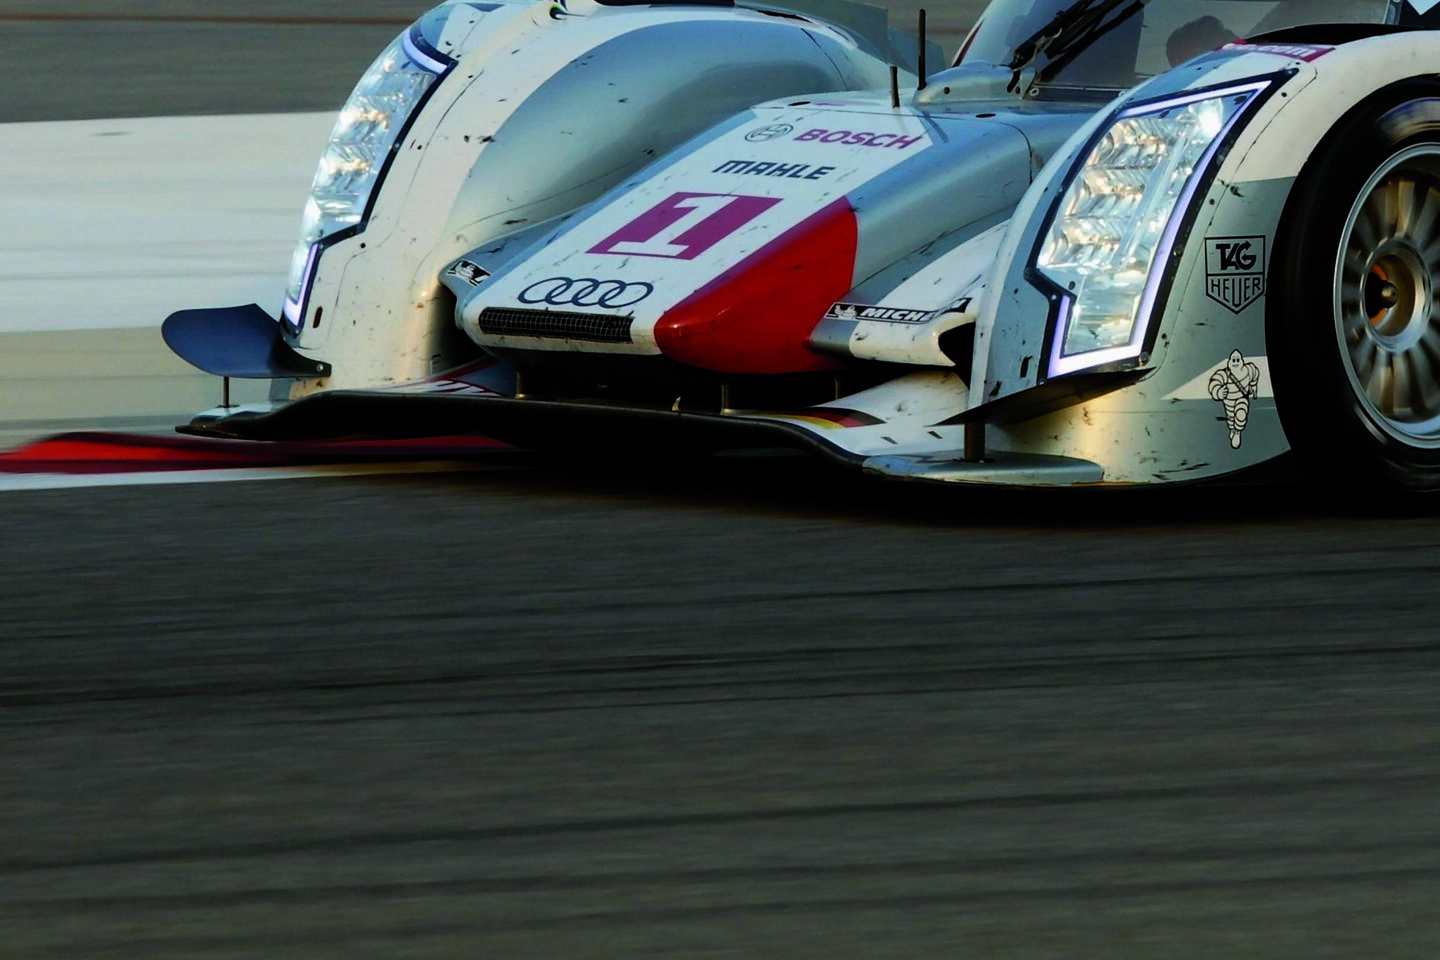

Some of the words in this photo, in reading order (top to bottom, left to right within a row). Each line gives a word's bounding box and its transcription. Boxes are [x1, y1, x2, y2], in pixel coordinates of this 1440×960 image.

[793, 128, 923, 150] BOSCH
[711, 159, 837, 181] MAHLE
[606, 194, 740, 259] 1
[1215, 240, 1257, 271] TAG
[1210, 276, 1262, 308] HEUER
